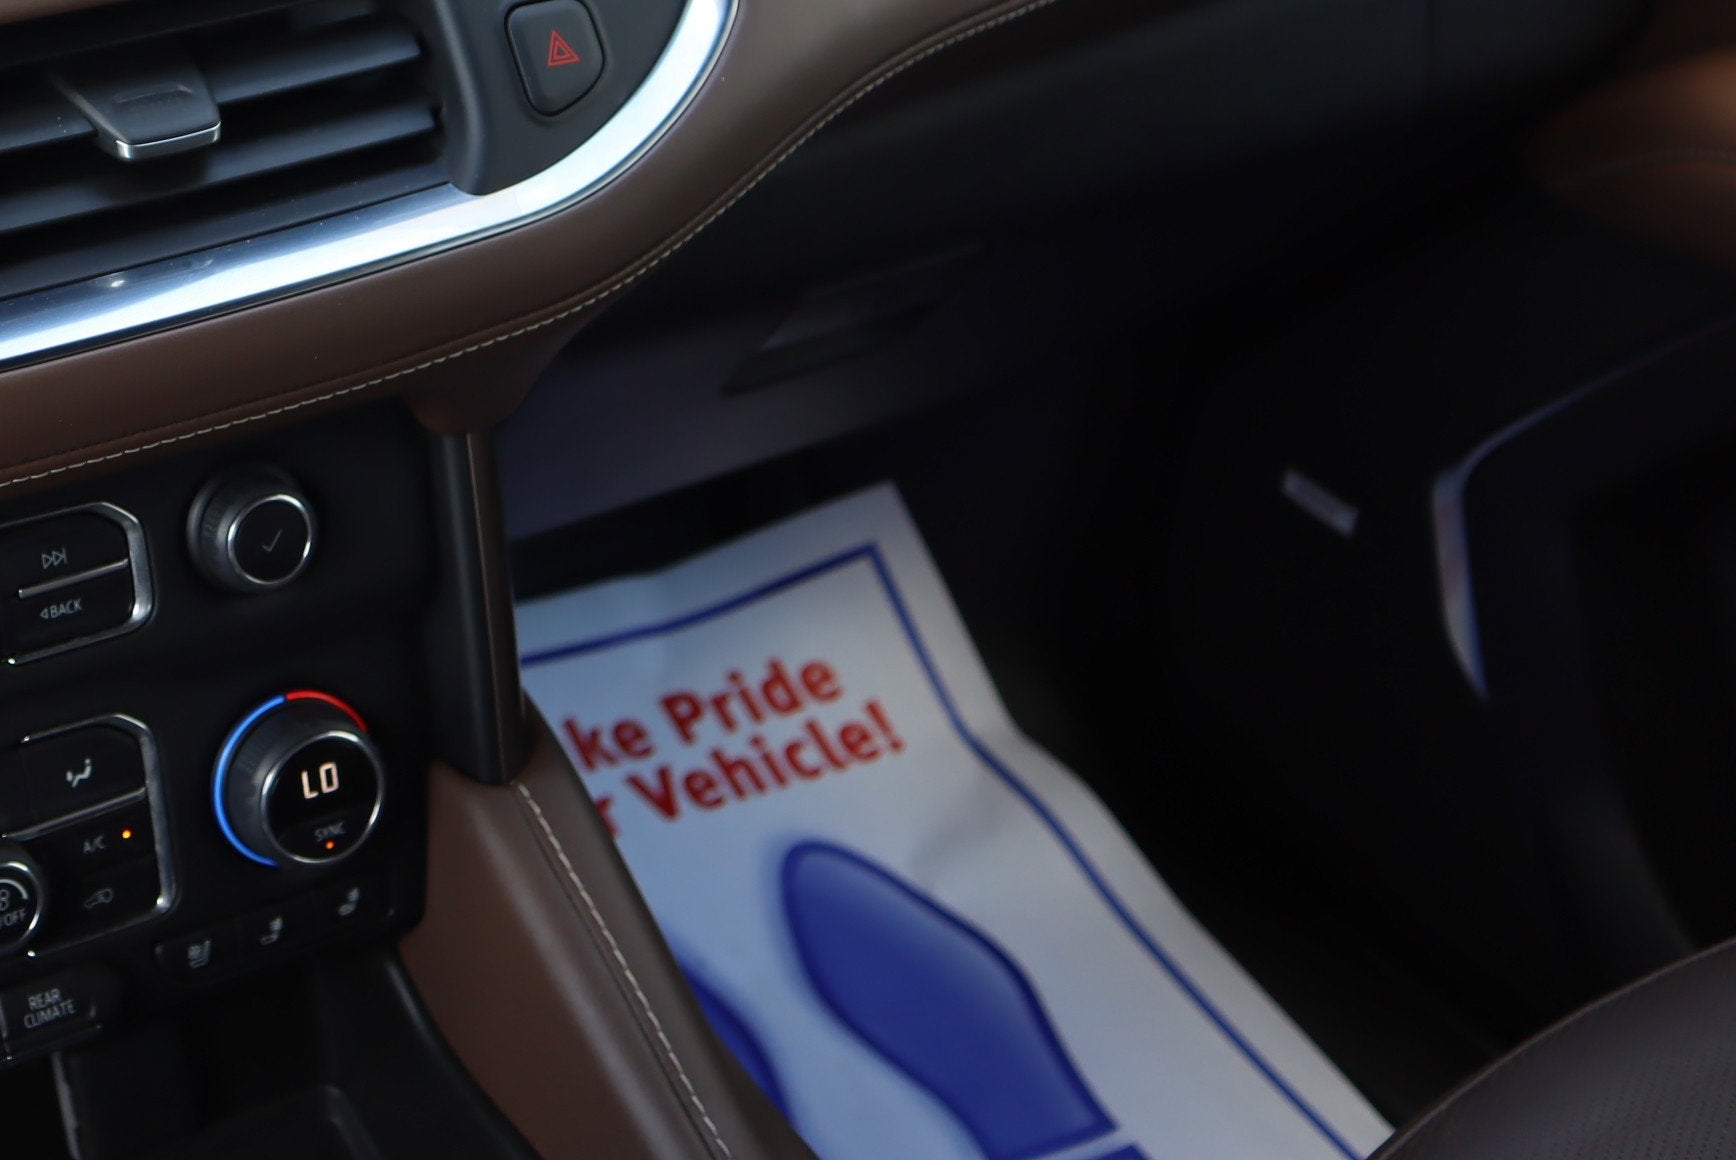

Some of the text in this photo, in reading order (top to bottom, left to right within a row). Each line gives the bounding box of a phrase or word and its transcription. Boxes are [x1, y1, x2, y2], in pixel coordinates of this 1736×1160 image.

[49, 597, 83, 619] BACK
[562, 658, 844, 771] ke Pride
[624, 700, 905, 821] Vehicle!
[301, 762, 339, 799] LO
[83, 834, 105, 854] A/C
[23, 999, 78, 1030] CLIMATE
[28, 987, 63, 1011] REAR
